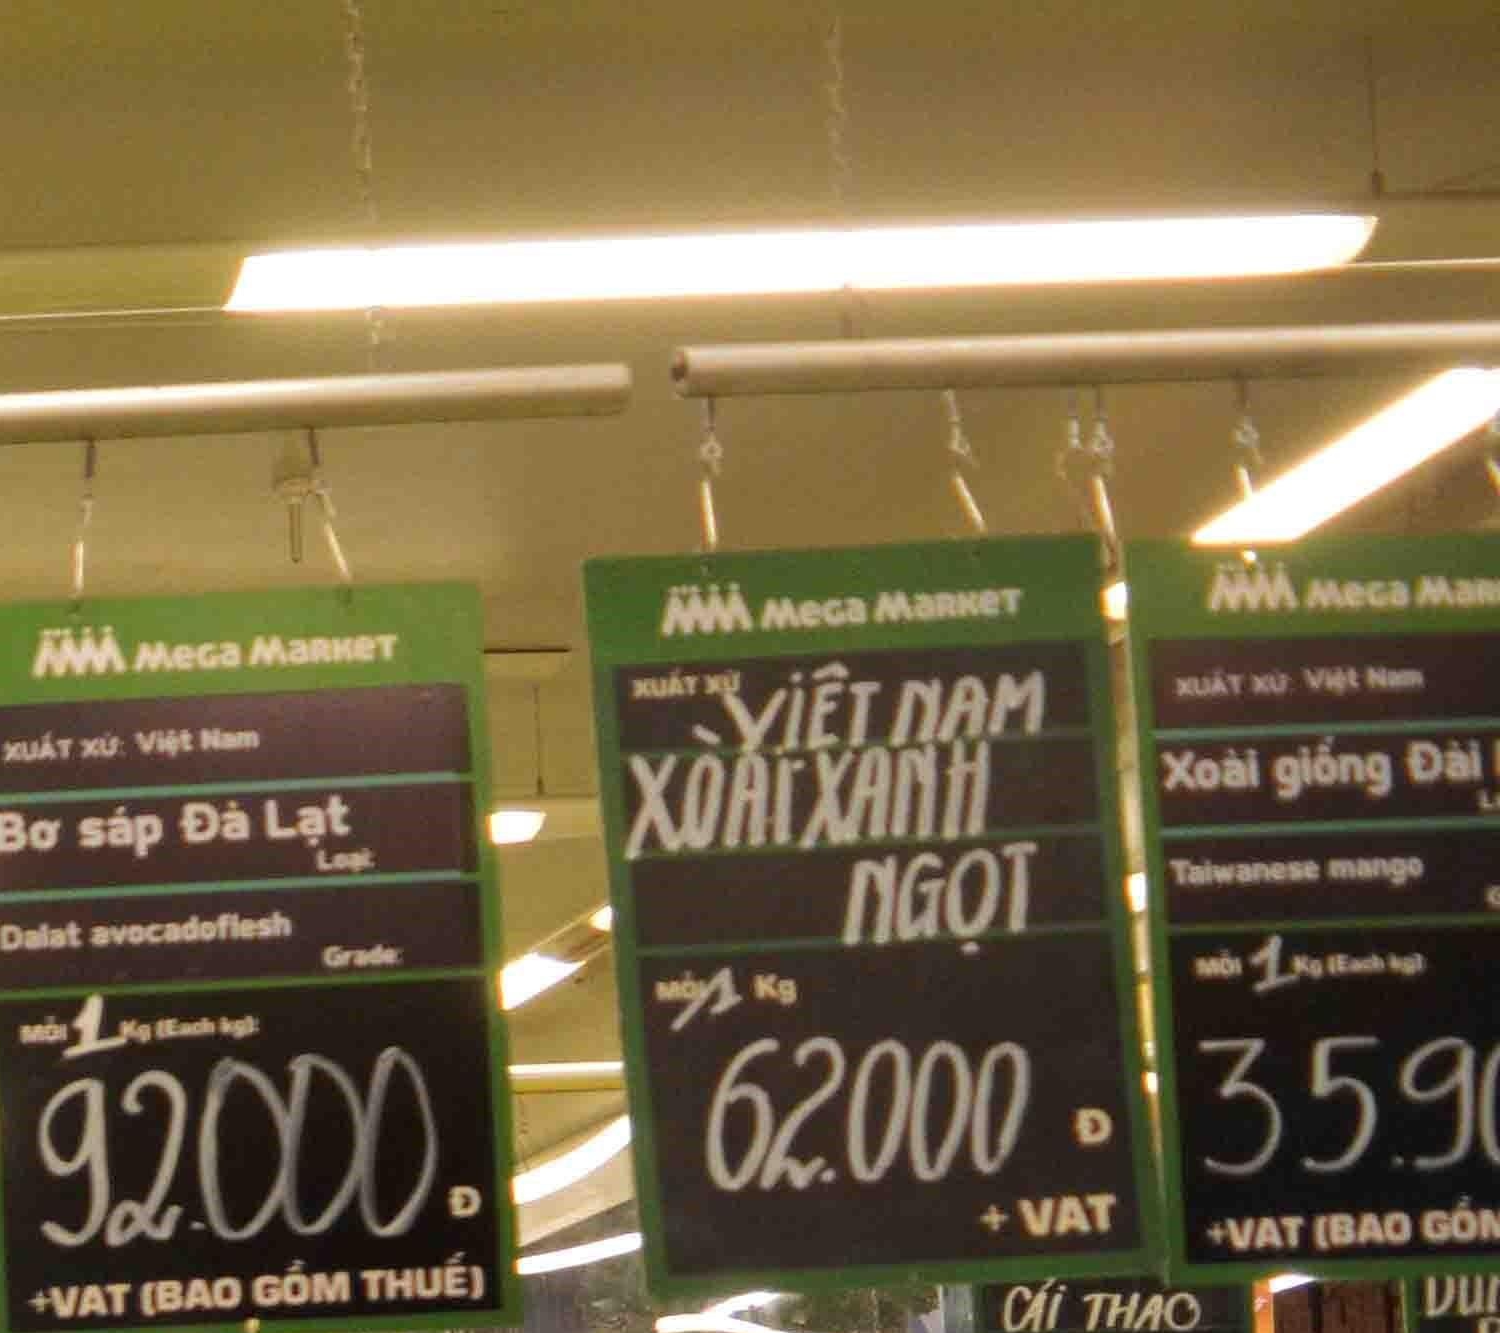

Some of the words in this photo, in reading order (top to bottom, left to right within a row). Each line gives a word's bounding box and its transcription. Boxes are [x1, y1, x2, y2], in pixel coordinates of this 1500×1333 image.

[891, 669, 1046, 747] NAM
[802, 739, 990, 850] XANH
[1161, 751, 1259, 791] Xoài
[1407, 742, 1483, 782] Đài
[77, 803, 162, 858] sáp
[266, 795, 350, 846] Lạt
[843, 842, 1039, 954] NGỌT
[1169, 858, 1320, 886] Taiwanese
[1329, 853, 1424, 883] mango
[1019, 1195, 1116, 1236] VAT
